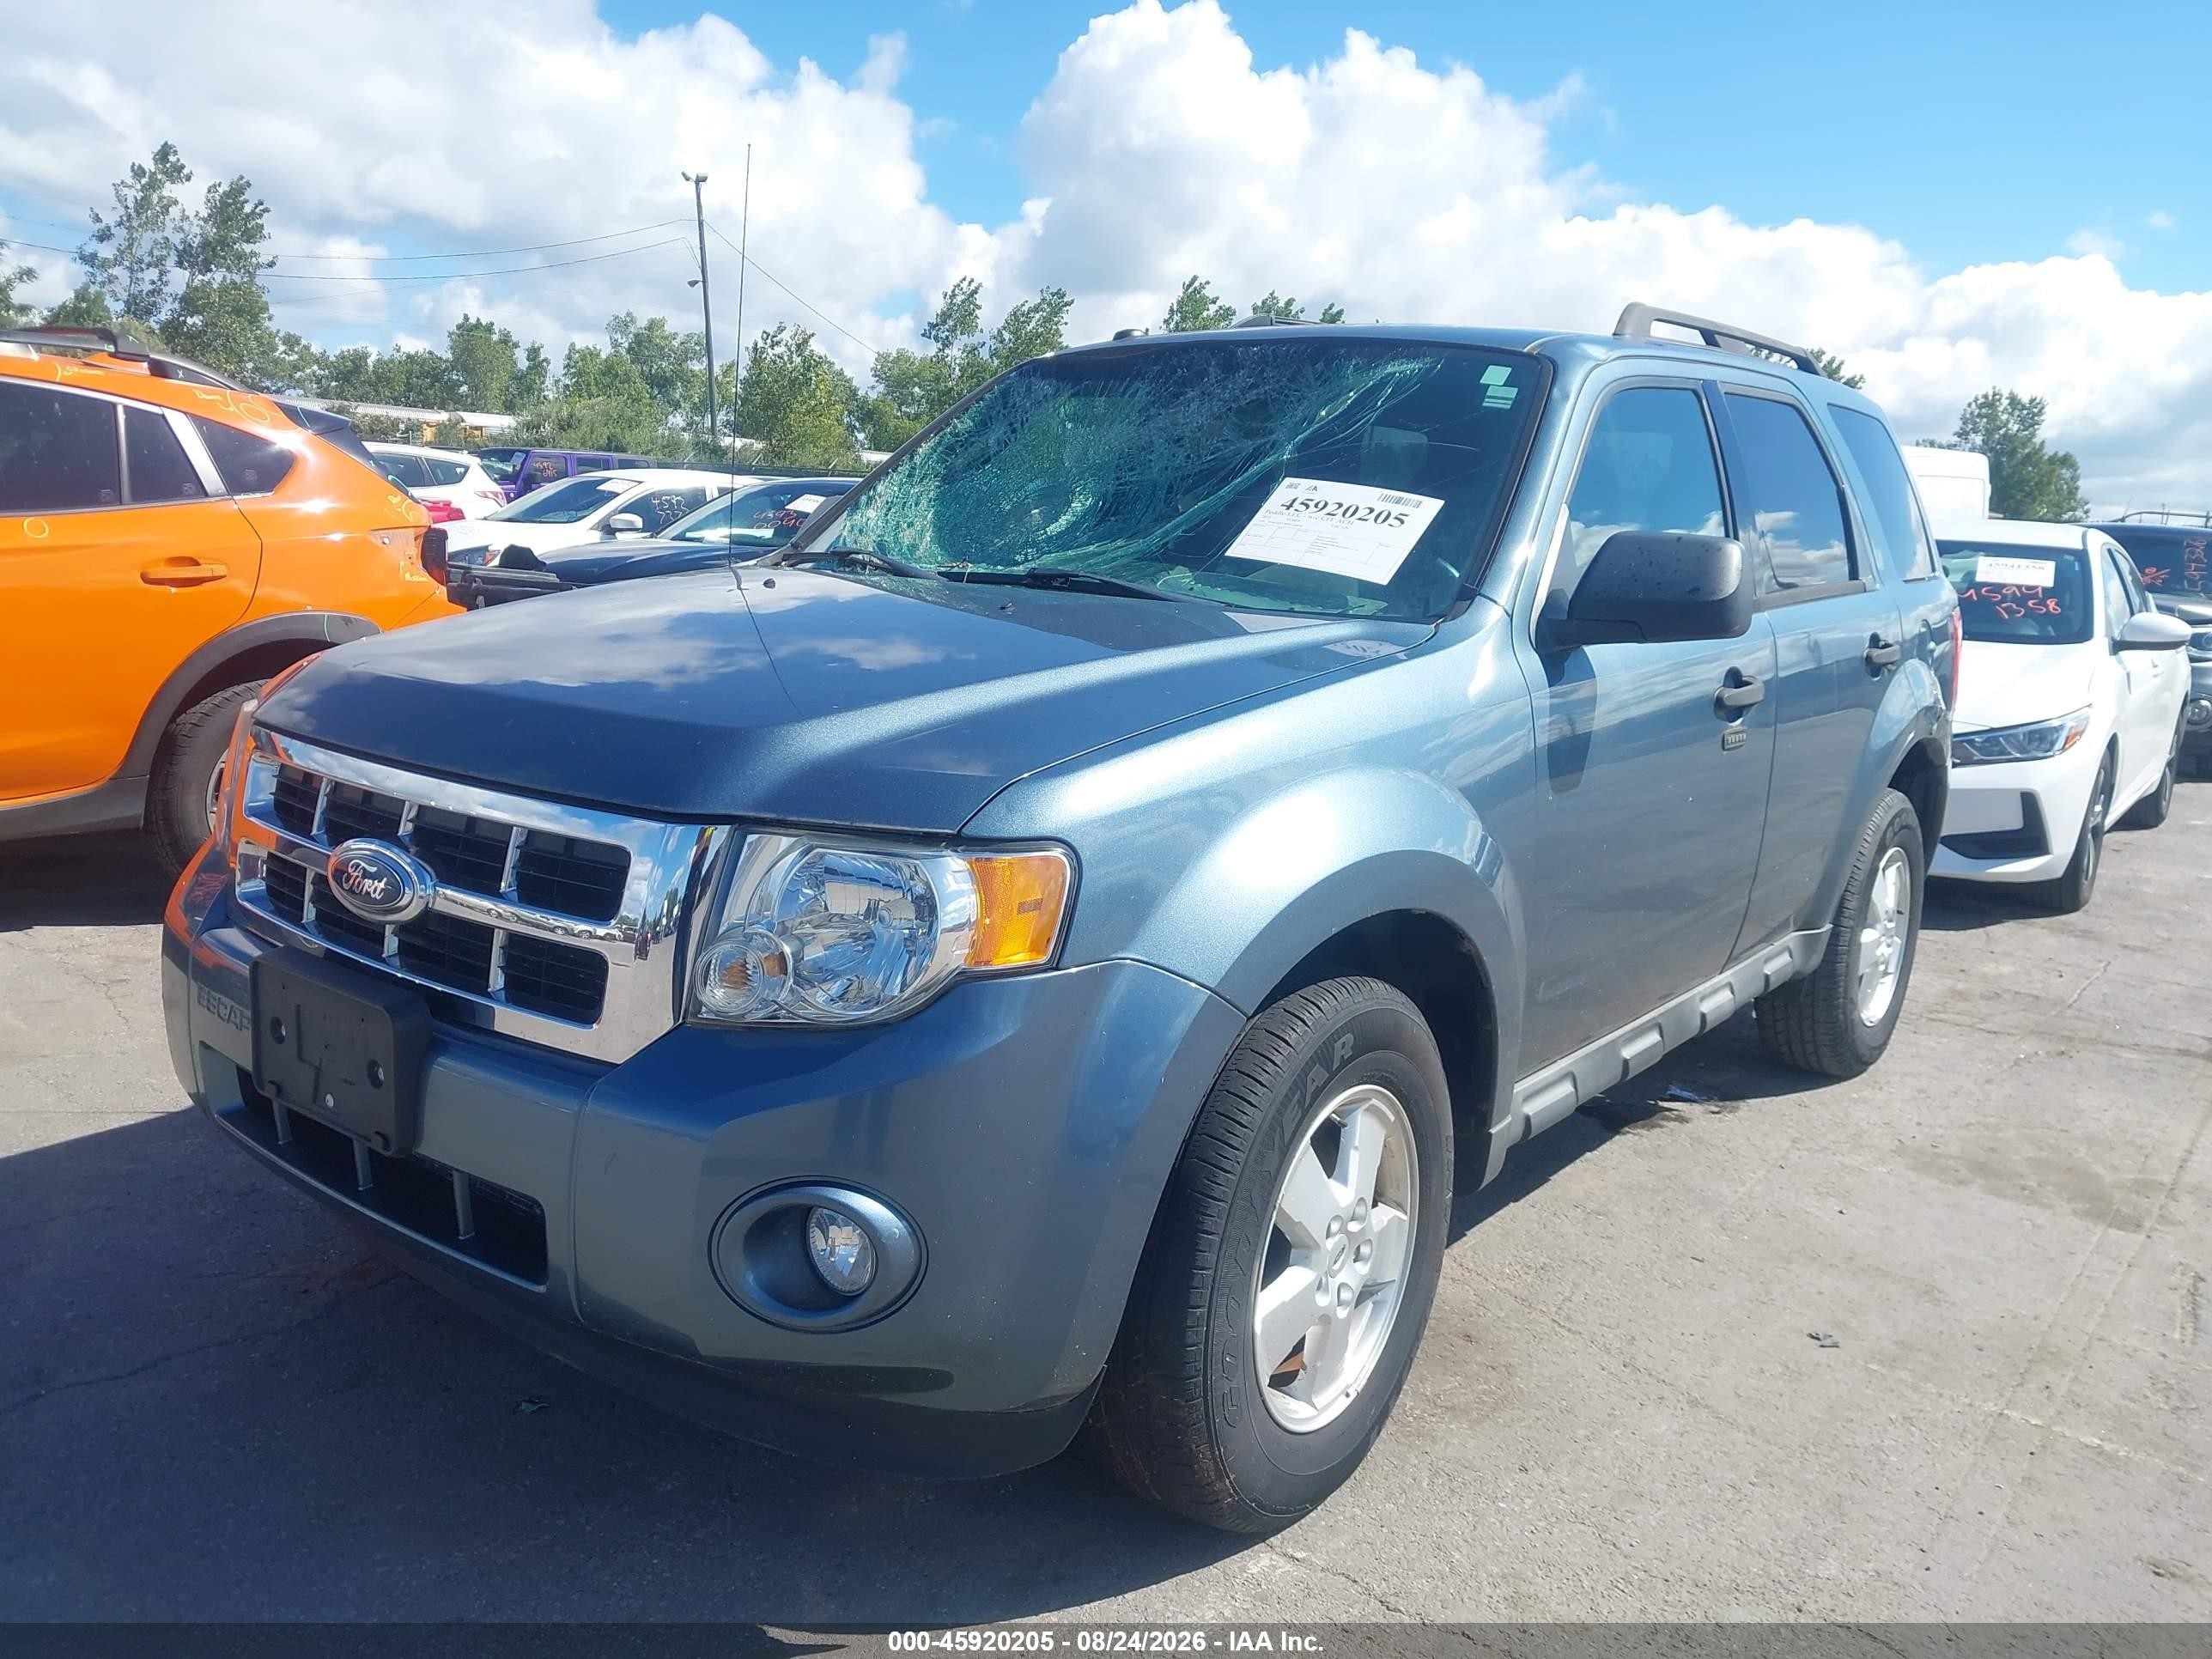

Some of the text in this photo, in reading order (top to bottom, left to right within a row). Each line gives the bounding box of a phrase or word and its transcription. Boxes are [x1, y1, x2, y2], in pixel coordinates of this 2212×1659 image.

[1279, 496, 1411, 528] 45920205
[1995, 598, 2061, 619] 1358
[342, 859, 392, 900] Ford
[197, 986, 251, 1032] ESCAP
